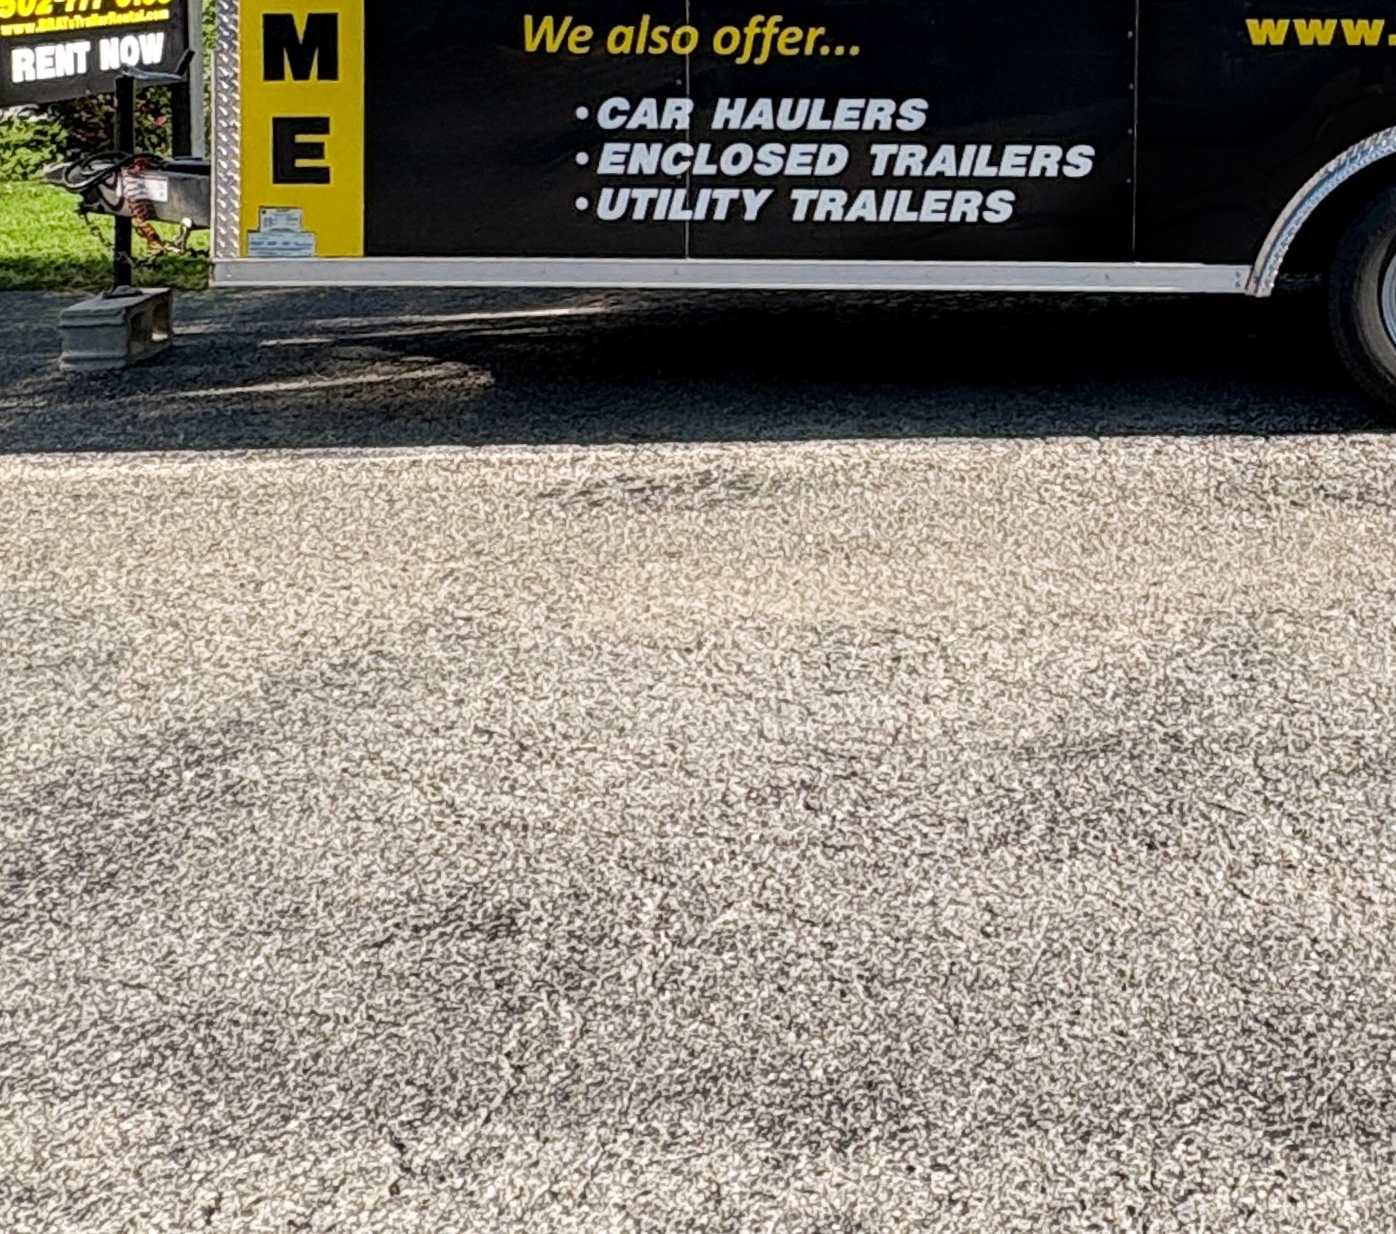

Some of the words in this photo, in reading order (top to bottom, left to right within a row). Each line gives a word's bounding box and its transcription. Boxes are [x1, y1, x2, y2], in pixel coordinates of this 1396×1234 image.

[11, 40, 91, 83] RENT
[99, 32, 164, 71] NOW
[524, 14, 594, 54] We
[606, 14, 700, 56] also
[712, 14, 861, 65] offer...
[262, 12, 339, 185] ME
[597, 96, 695, 130] CAR
[711, 97, 929, 131] HAULERS
[596, 142, 849, 176] ENCLOSED
[870, 143, 1096, 178] TRAILERS
[596, 187, 774, 221] UTILITY
[790, 188, 1016, 223] TRAILERS
